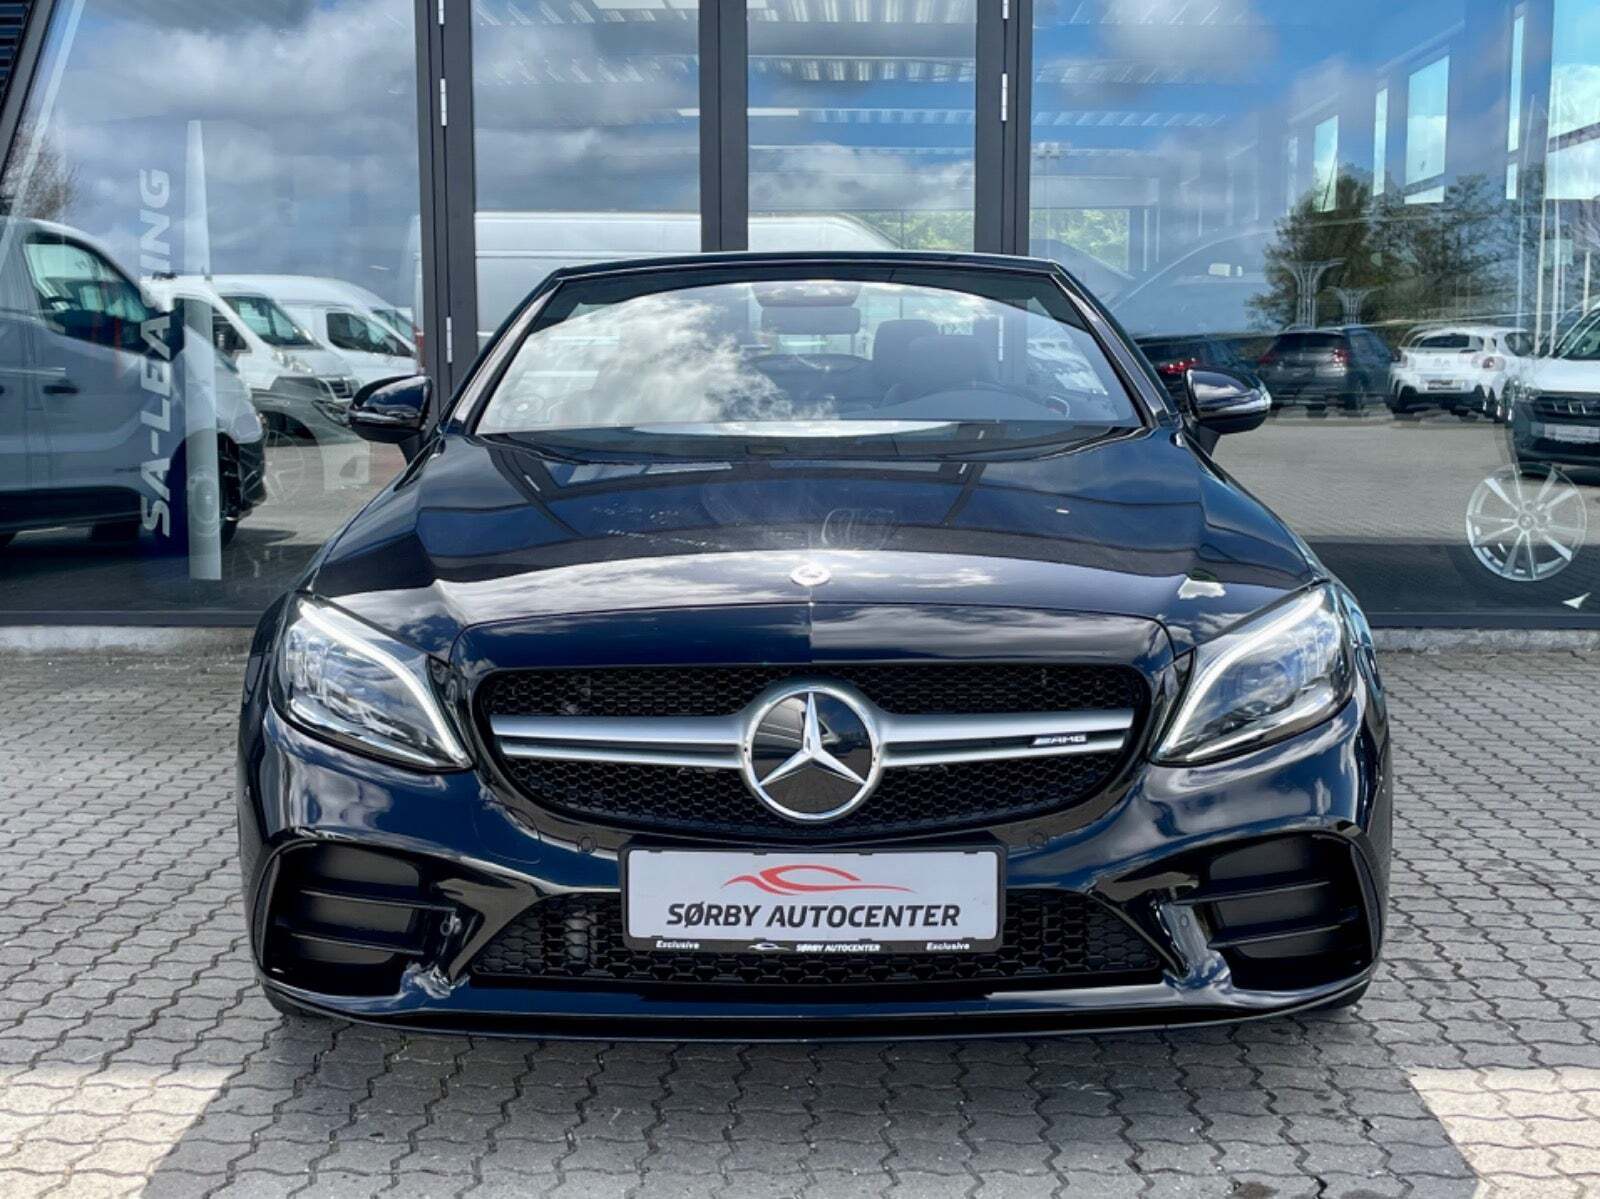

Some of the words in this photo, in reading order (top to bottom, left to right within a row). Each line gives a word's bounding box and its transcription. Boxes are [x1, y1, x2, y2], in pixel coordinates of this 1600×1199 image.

[139, 168, 171, 537] SA-LEAING
[666, 902, 761, 928] SØRBY
[766, 904, 961, 928] AUTOCENTER
[655, 940, 700, 949] Exclusive
[825, 943, 881, 952] AUTOCENTER
[926, 942, 970, 951] Exclusive
